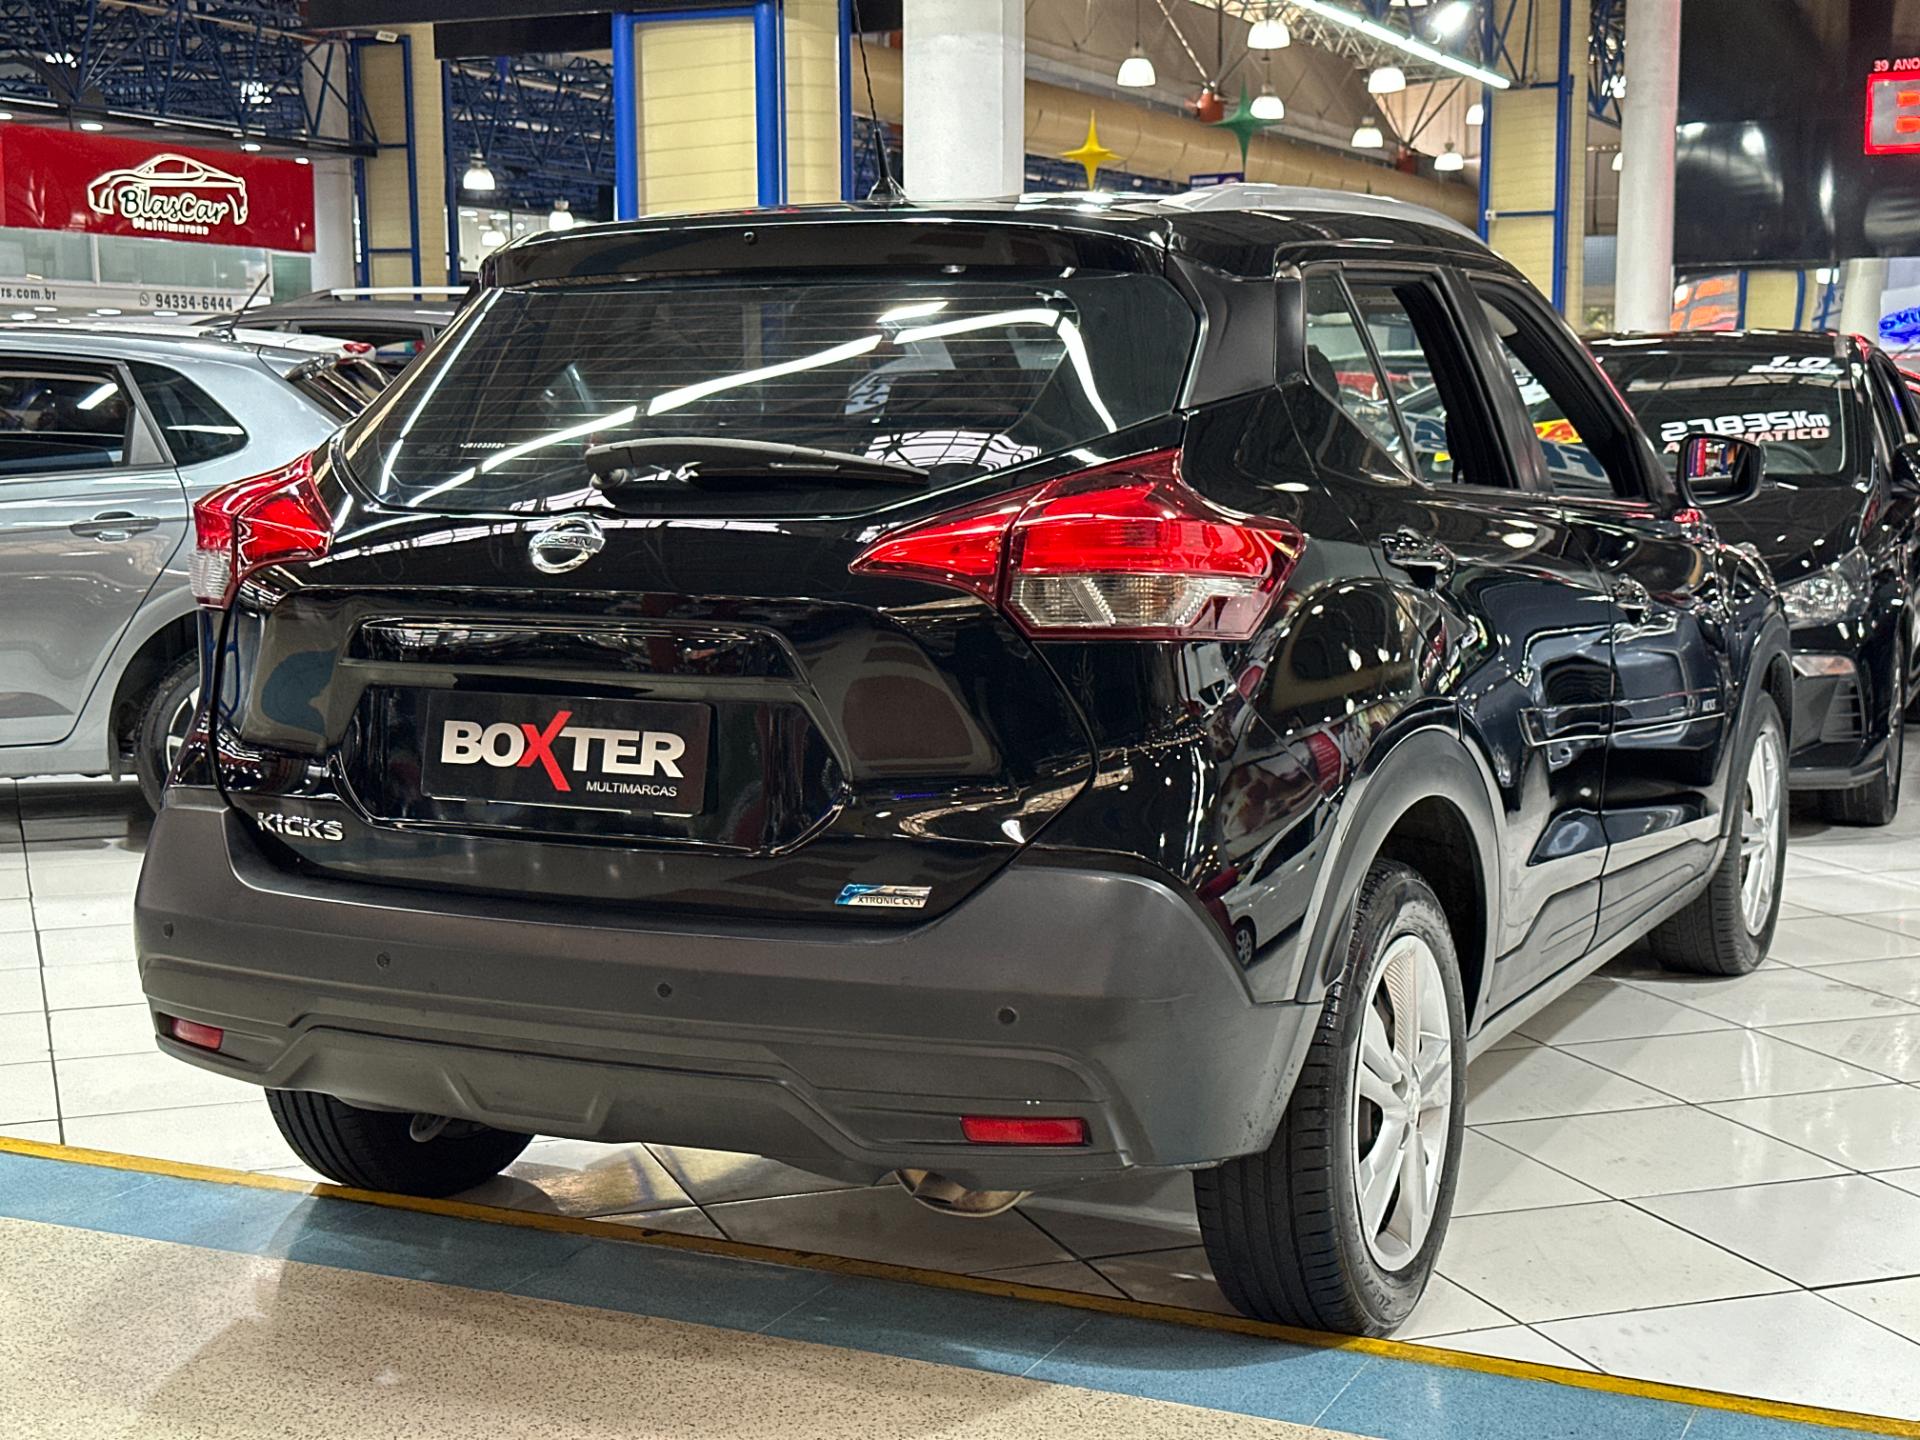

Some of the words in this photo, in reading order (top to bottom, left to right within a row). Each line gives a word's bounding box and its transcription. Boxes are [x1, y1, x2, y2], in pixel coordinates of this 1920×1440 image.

[1873, 59, 1889, 72] 39
[119, 186, 229, 224] BlasCar
[155, 293, 233, 311] 94334-6444
[1770, 355, 1832, 368] 1.0
[441, 710, 685, 792] BOXTER
[586, 781, 678, 797] MULTIMARCAS
[257, 811, 343, 841] KICKS
[857, 895, 901, 906] XTRONIC
[902, 897, 922, 907] CVT
